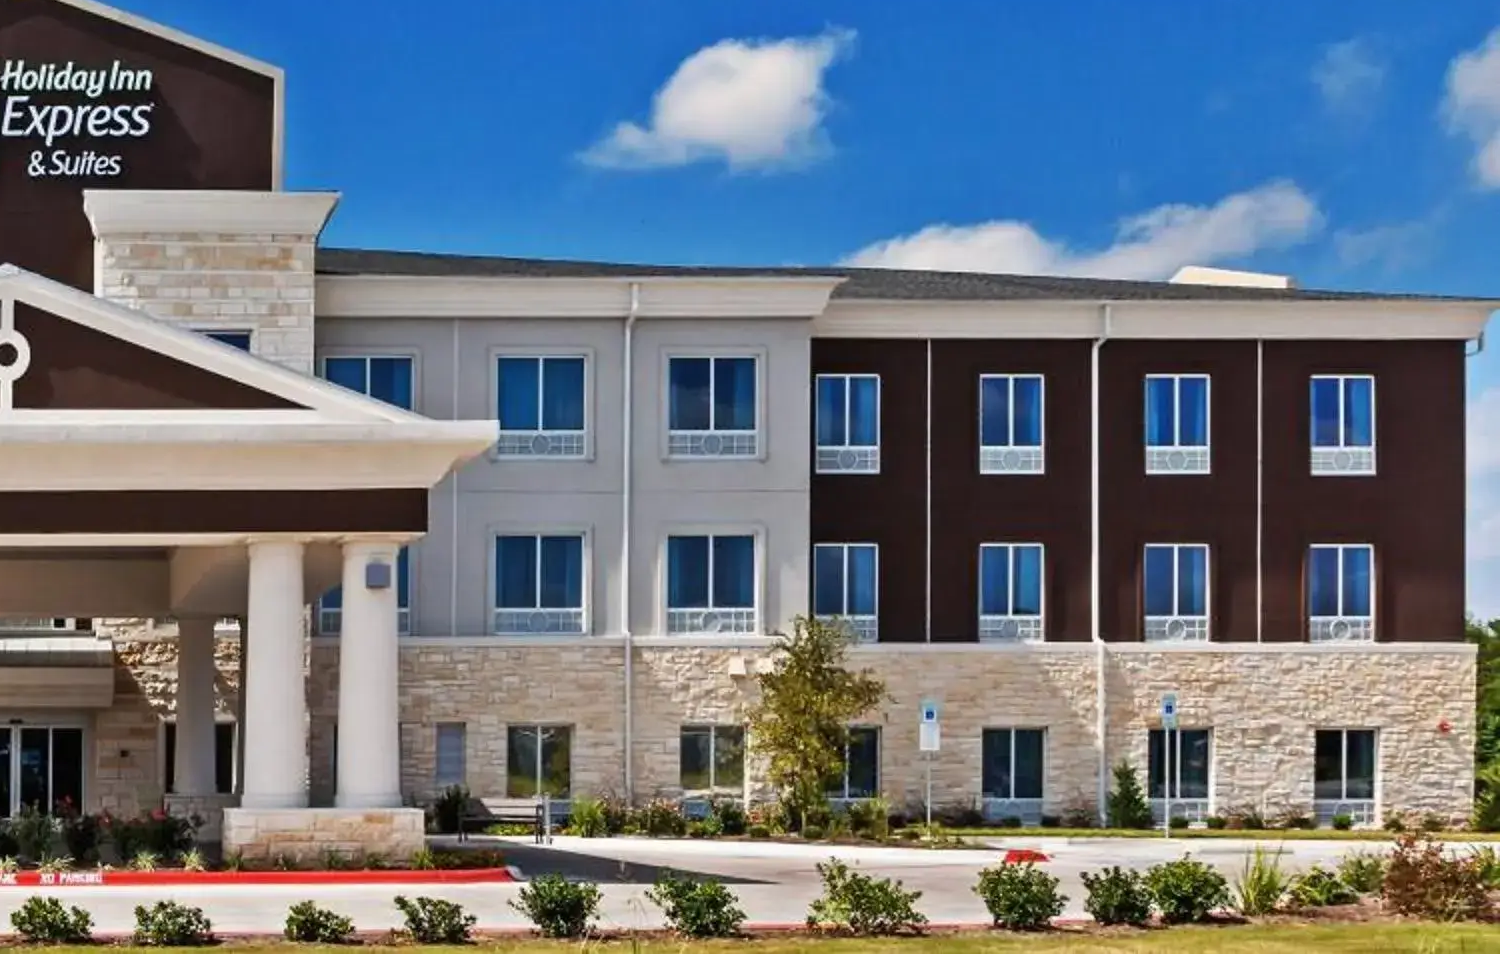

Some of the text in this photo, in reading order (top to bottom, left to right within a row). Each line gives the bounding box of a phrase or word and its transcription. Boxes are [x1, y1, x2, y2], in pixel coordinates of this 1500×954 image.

[1, 59, 153, 95] Holiday Inn
[1, 95, 151, 146] Express
[27, 150, 122, 176] & Suites
